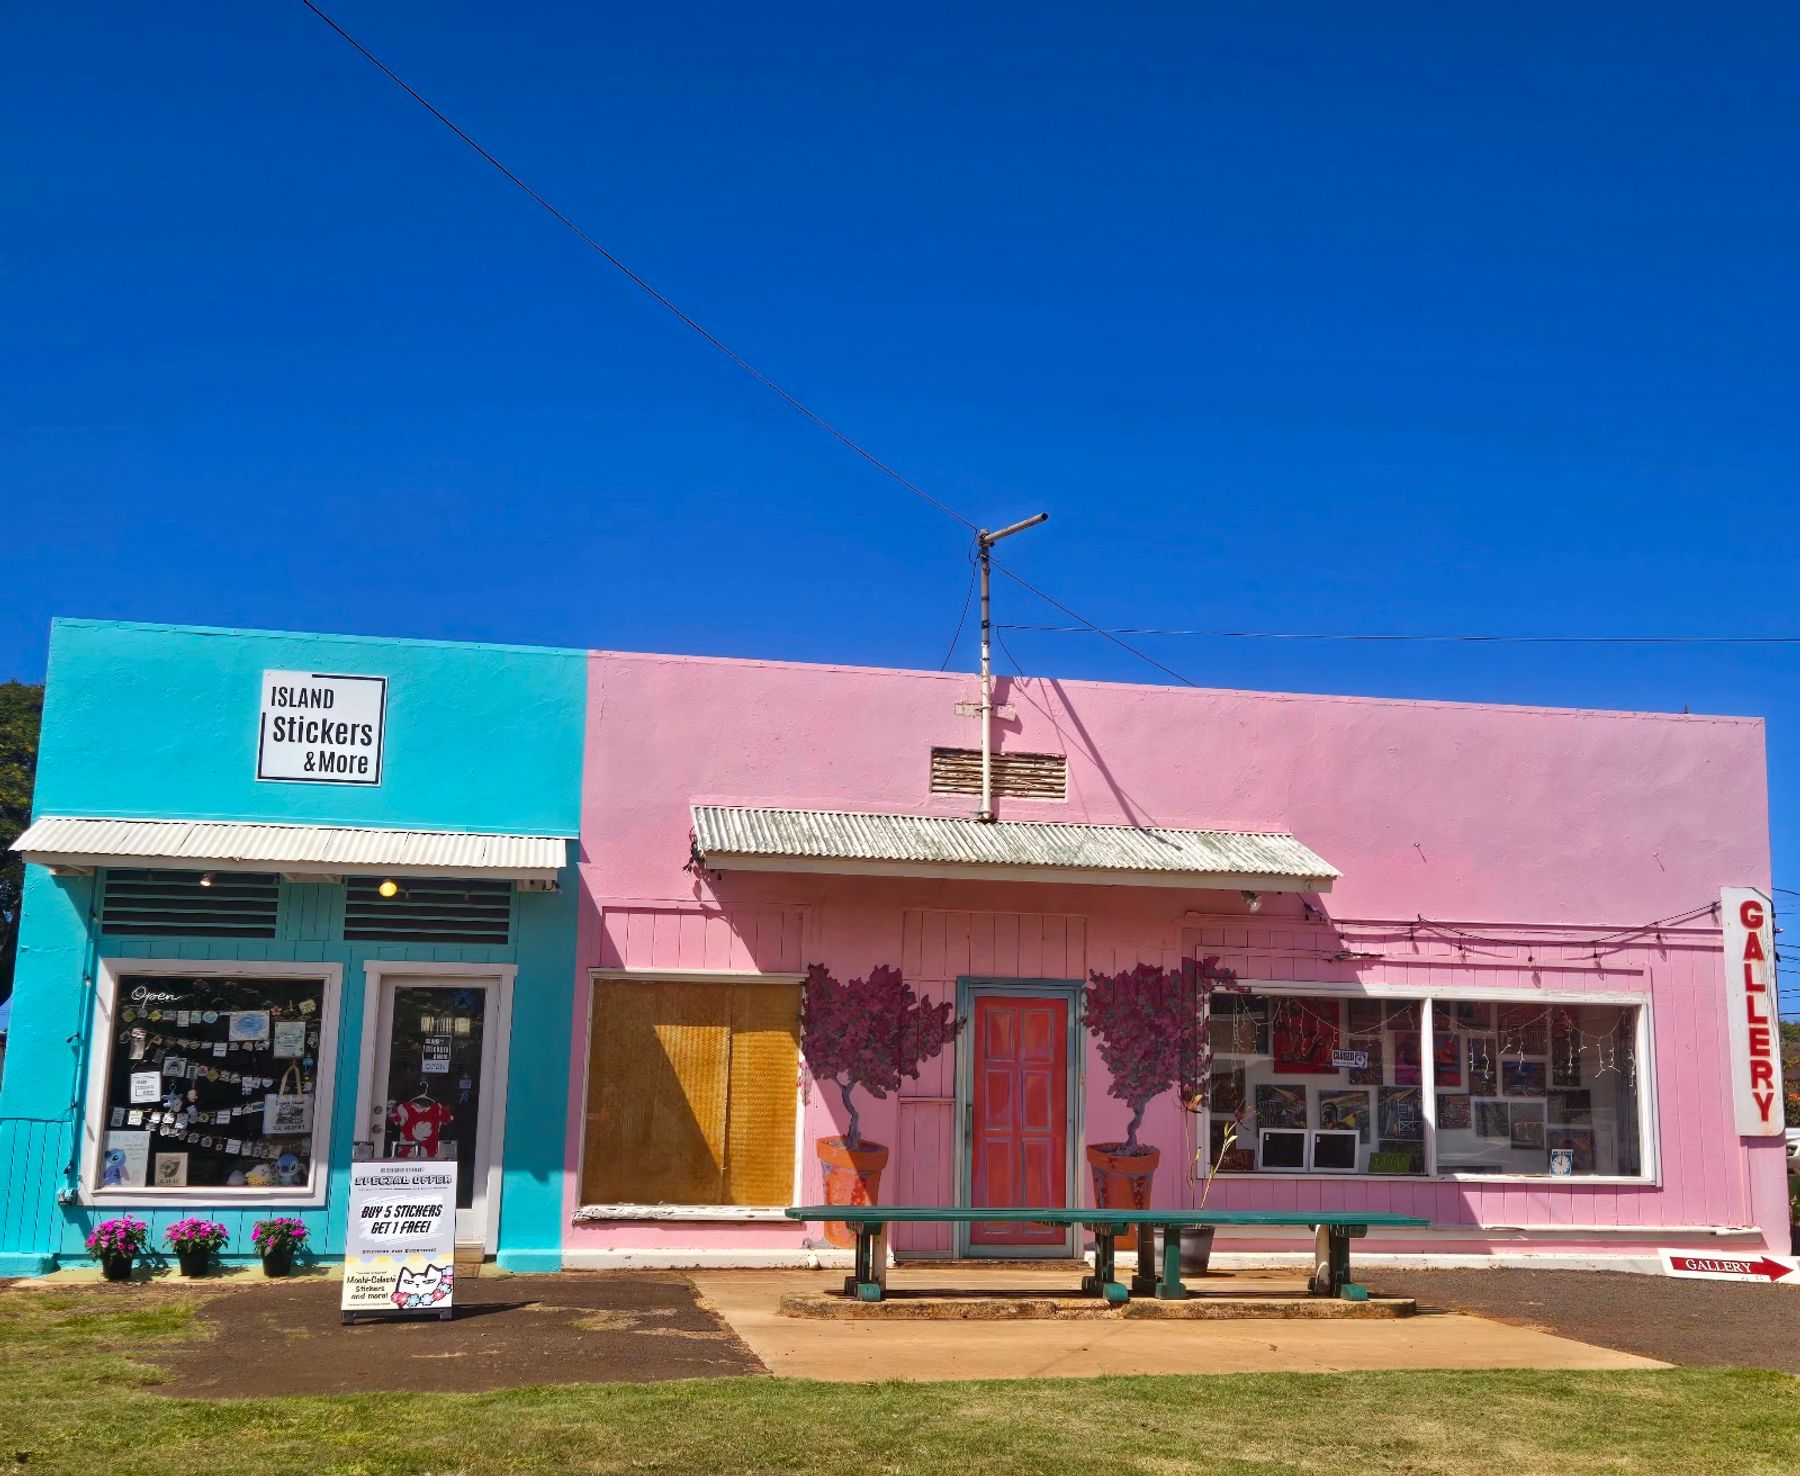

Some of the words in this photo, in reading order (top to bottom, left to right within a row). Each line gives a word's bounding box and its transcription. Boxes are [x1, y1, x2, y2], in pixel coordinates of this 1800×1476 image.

[271, 686, 334, 709] ISLAND
[273, 715, 373, 746] Stickers
[131, 986, 188, 1009] Open
[1740, 900, 1774, 1122] GALLERY
[1333, 1050, 1355, 1061] CLOSED
[354, 1175, 410, 1186] SPECIAL
[412, 1174, 453, 1185] OFFER
[361, 1205, 383, 1219] BUY
[384, 1205, 393, 1218] 5
[394, 1204, 443, 1218] STICKERS
[371, 1221, 392, 1234] GET
[392, 1221, 399, 1234] 1
[400, 1220, 432, 1234] FREE!
[1685, 1259, 1752, 1273] GALLERY
[351, 1292, 366, 1300] and
